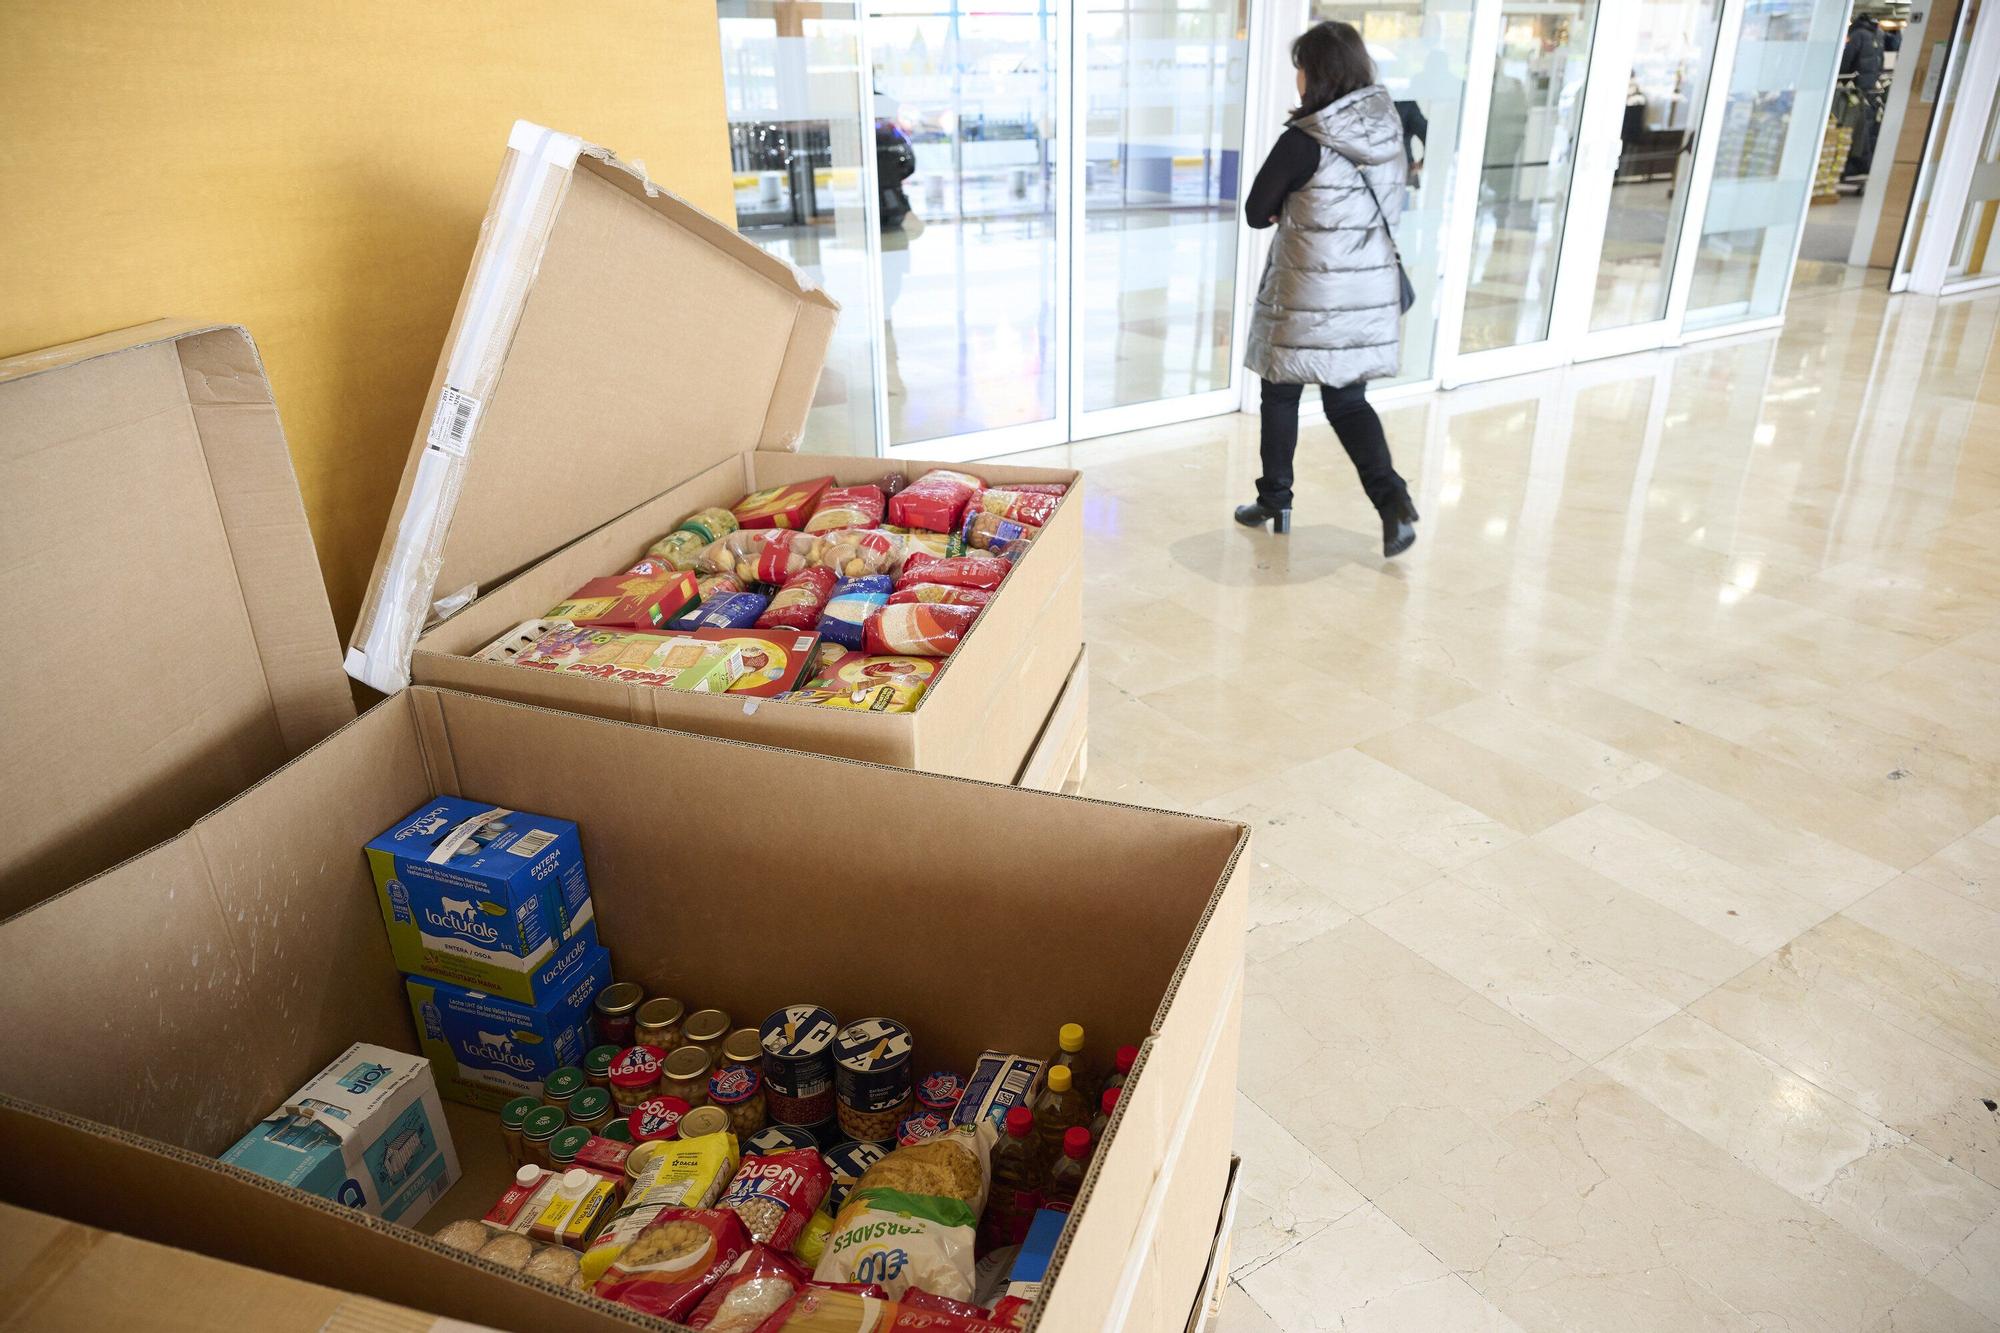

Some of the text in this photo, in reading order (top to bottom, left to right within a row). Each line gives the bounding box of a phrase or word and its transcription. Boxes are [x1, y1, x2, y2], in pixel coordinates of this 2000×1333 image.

[531, 848, 561, 877] ENTERA
[537, 860, 560, 881] OSOA
[424, 907, 498, 938] lacturale
[444, 944, 468, 954] ENTERA
[475, 951, 492, 960] OSOA
[543, 938, 586, 986] lacturale
[568, 974, 596, 1006] ENTERA
[574, 984, 594, 1008] OSOA
[462, 1040, 536, 1070] lacturale
